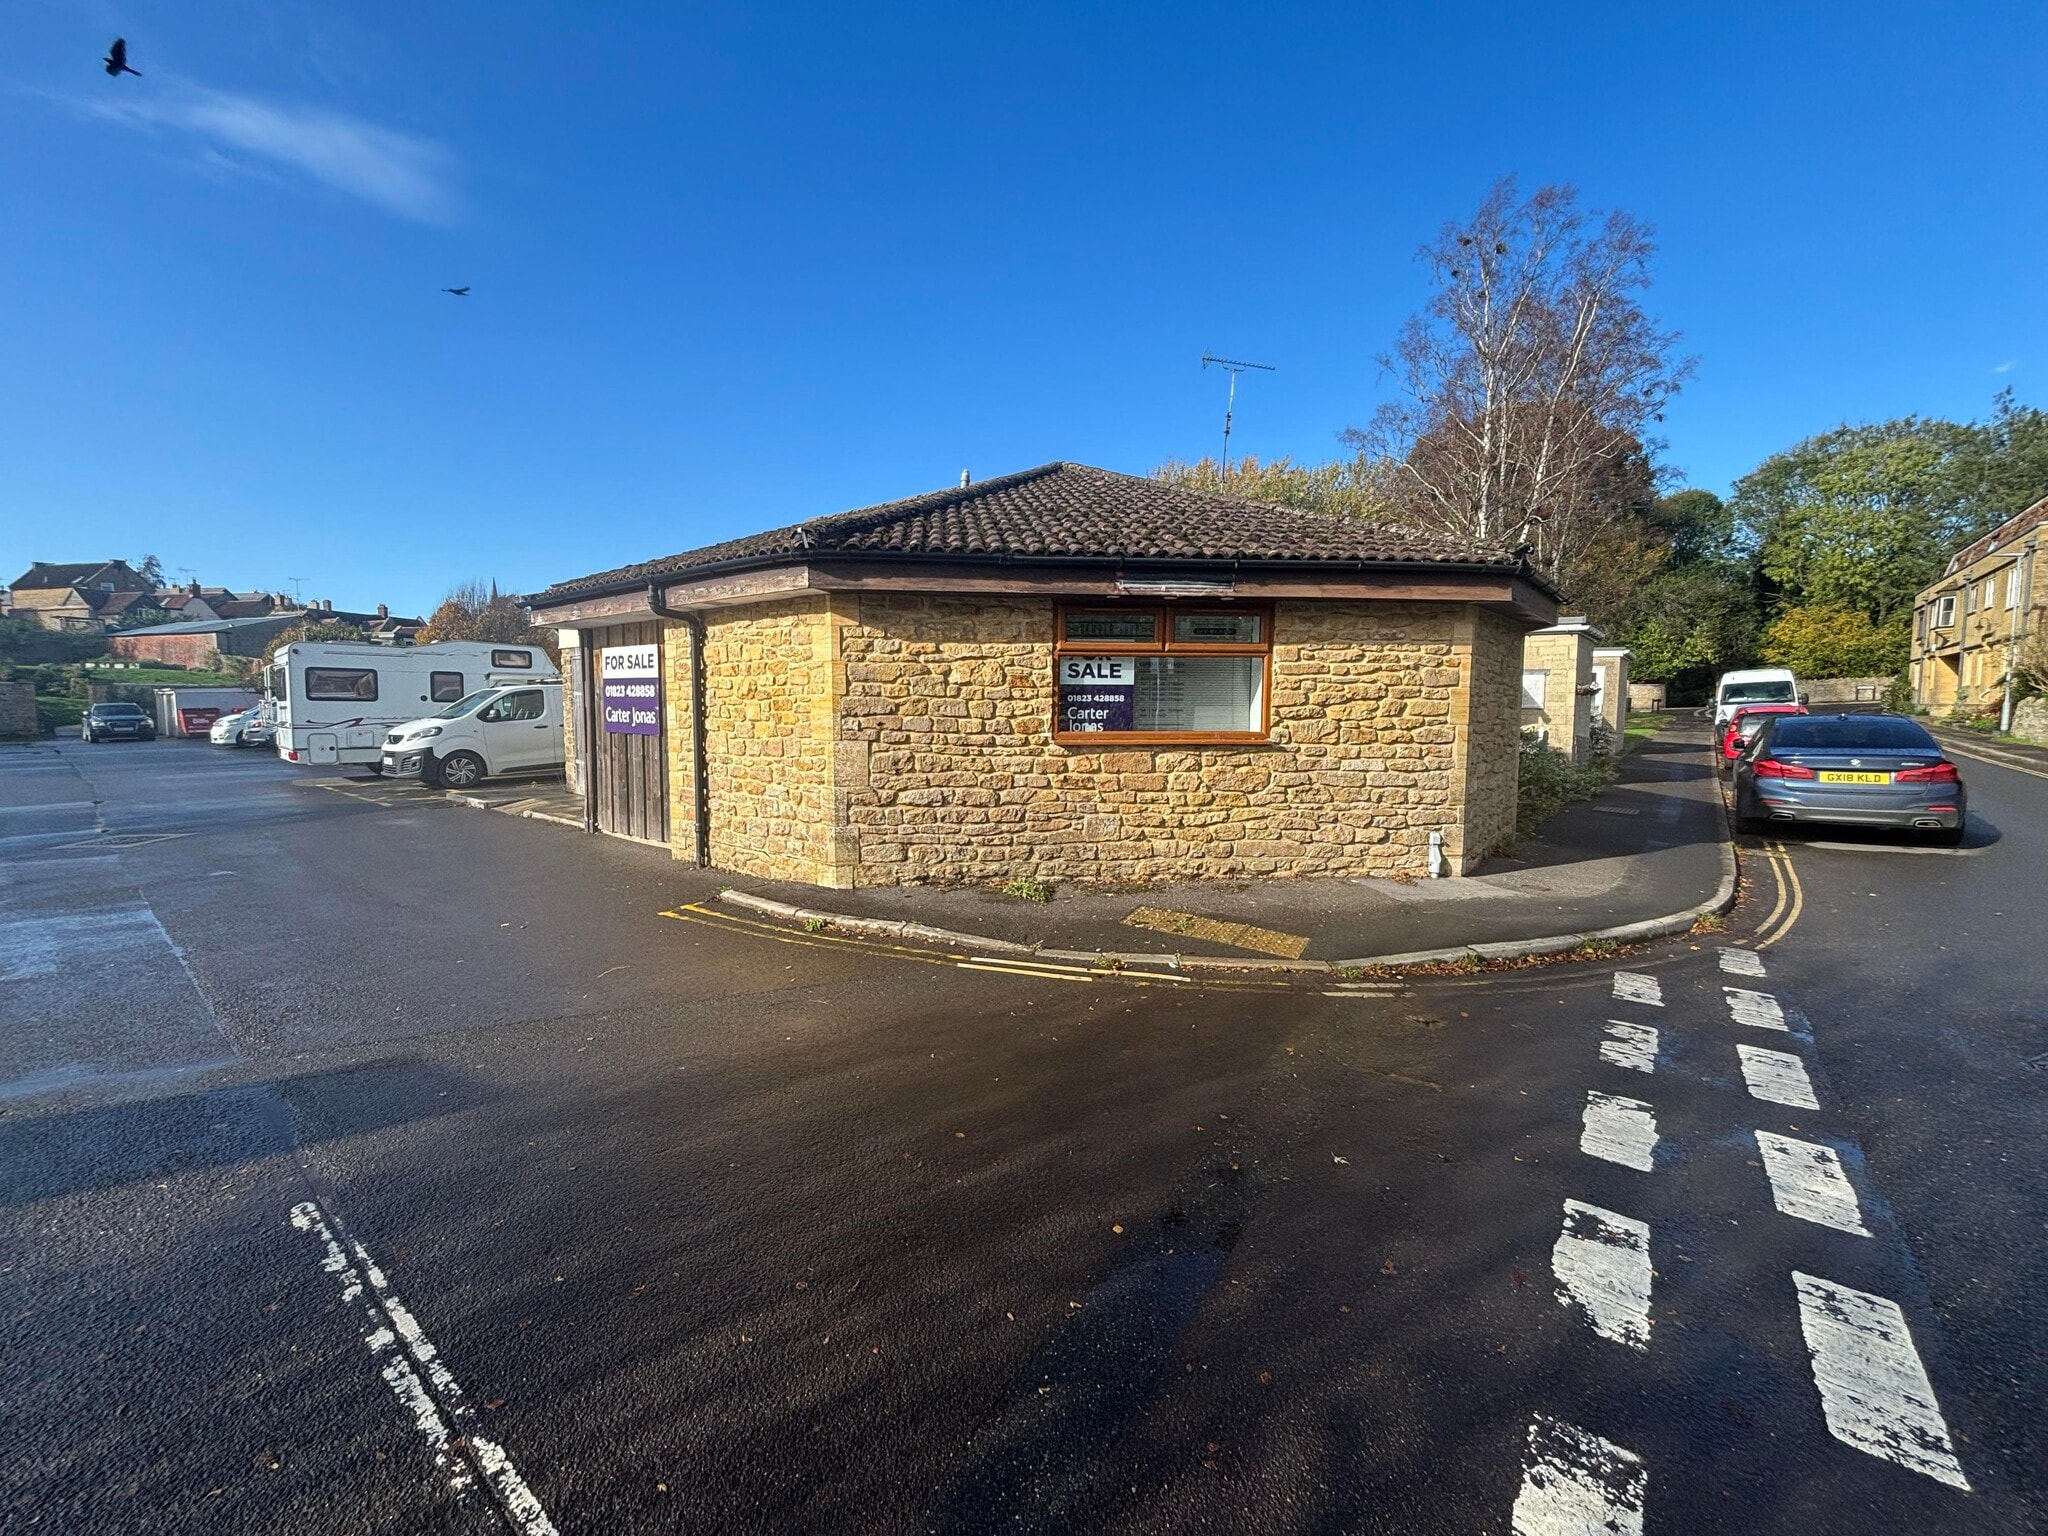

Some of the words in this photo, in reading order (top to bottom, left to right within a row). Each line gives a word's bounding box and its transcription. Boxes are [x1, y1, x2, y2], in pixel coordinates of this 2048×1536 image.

[605, 655, 624, 670] FOR
[627, 654, 654, 669] SALE
[1067, 663, 1122, 679] SALE
[605, 685, 625, 697] 01823
[626, 684, 655, 697] 428858
[1067, 694, 1092, 702] 01823
[1093, 694, 1125, 702] 428858
[605, 706, 630, 722] Carter
[631, 706, 656, 727] Jonas
[1067, 706, 1109, 720] Carter
[1827, 773, 1854, 782] GX18
[1857, 774, 1882, 783] KLD
